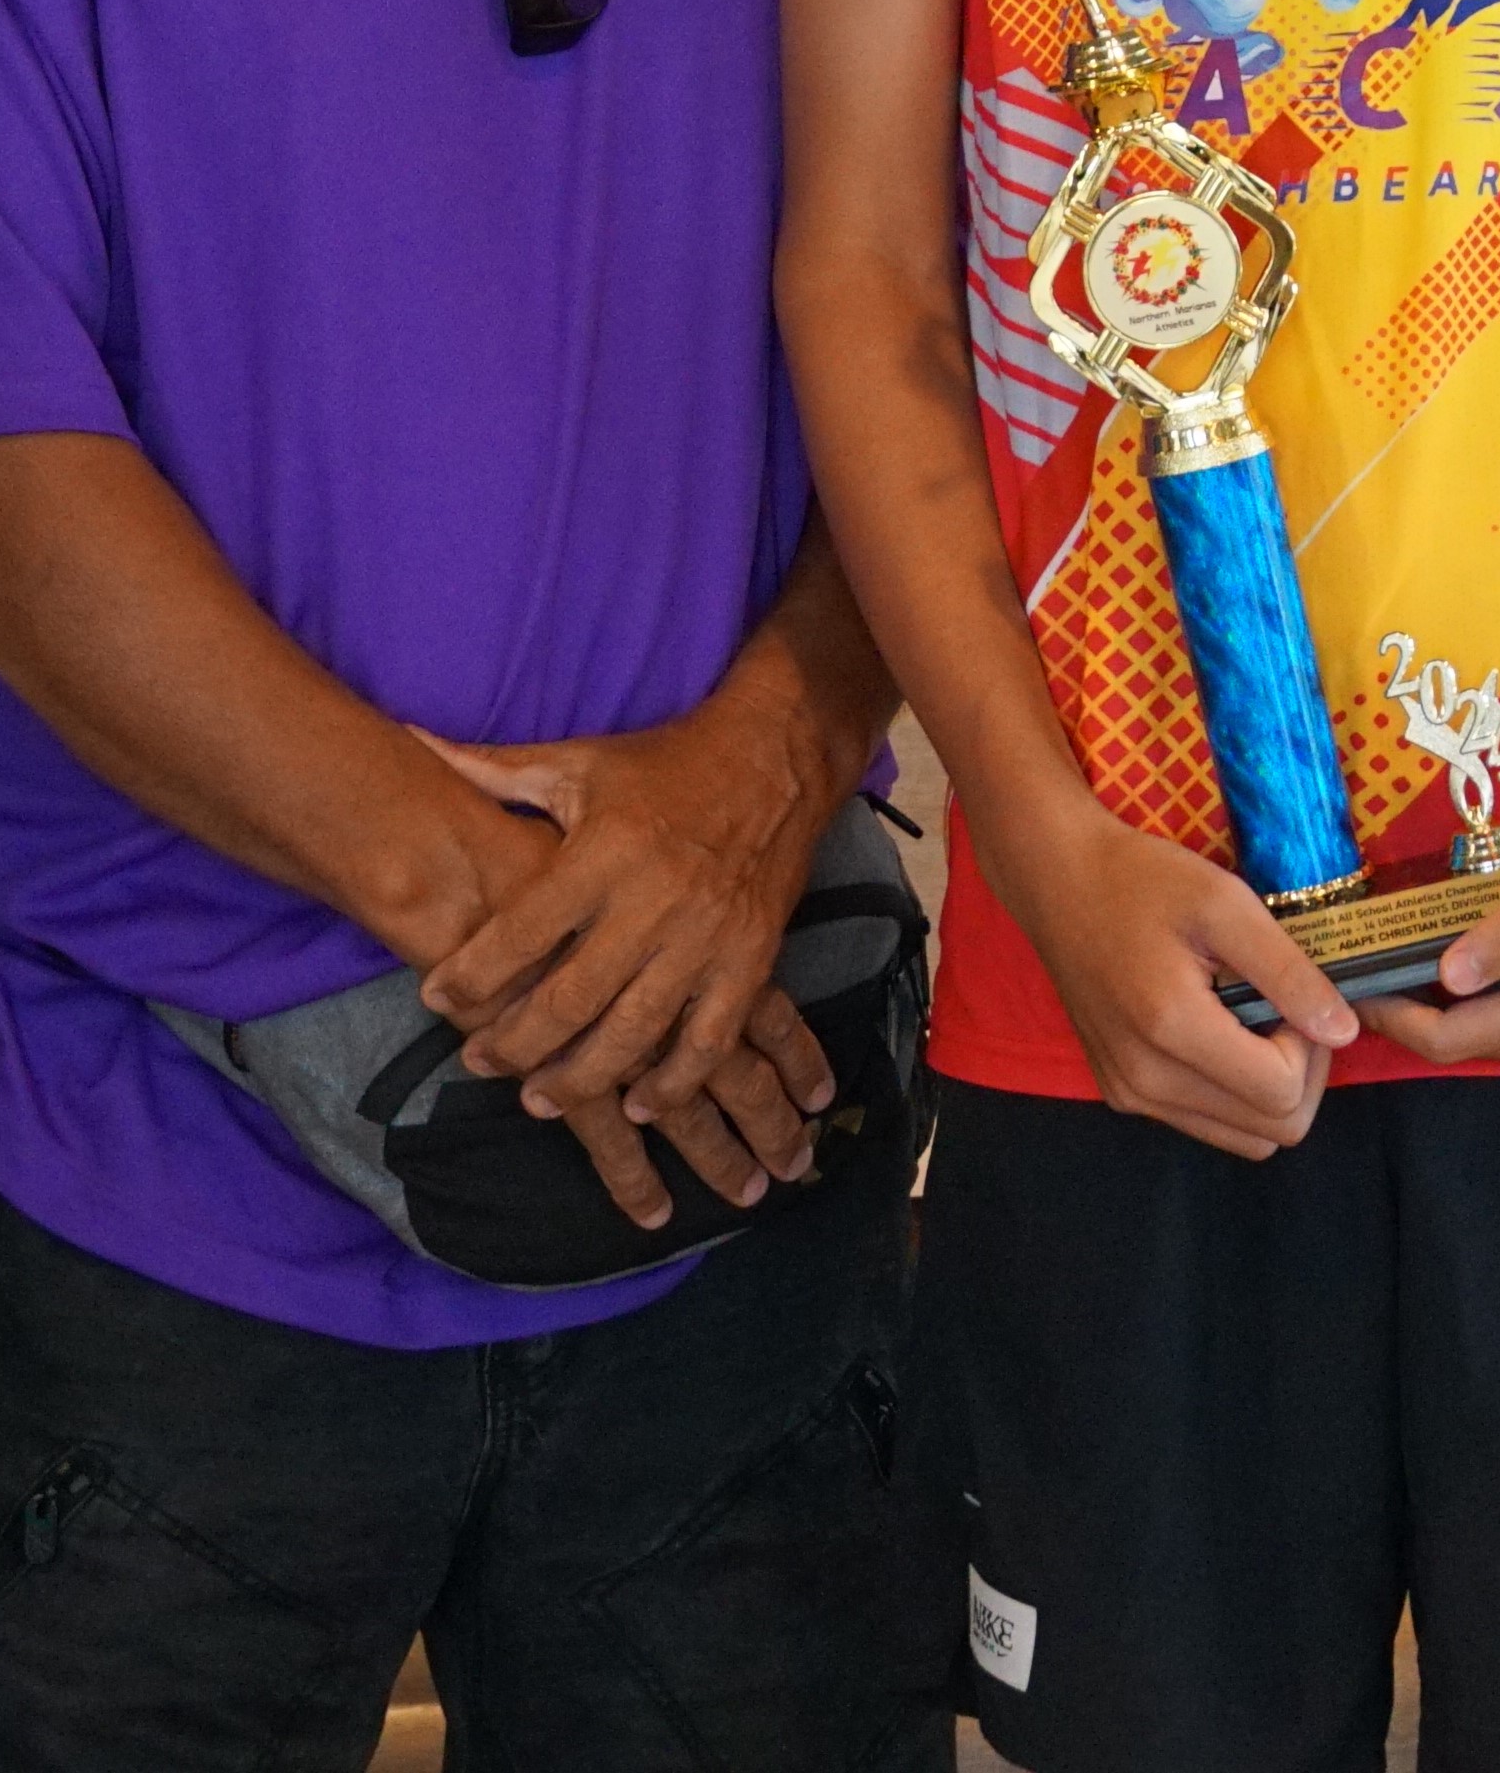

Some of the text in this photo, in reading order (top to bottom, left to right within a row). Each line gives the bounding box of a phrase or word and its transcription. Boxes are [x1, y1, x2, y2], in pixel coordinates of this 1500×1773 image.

[1129, 300, 1216, 325] Northern Marianas
[1155, 318, 1194, 332] Athletics
[1314, 927, 1352, 942] Athlete
[1377, 911, 1416, 927] UNDER
[1420, 903, 1449, 918] BOYS
[1452, 892, 1500, 910] DIVISION
[1338, 911, 1353, 922] All
[1355, 902, 1392, 918] School
[1396, 893, 1442, 909] Athletics
[1339, 934, 1376, 951] AGAPE
[1379, 920, 1438, 941] CHRISTIAN
[1441, 909, 1486, 927] SCHOOL
[974, 1594, 1014, 1650] NIKE
